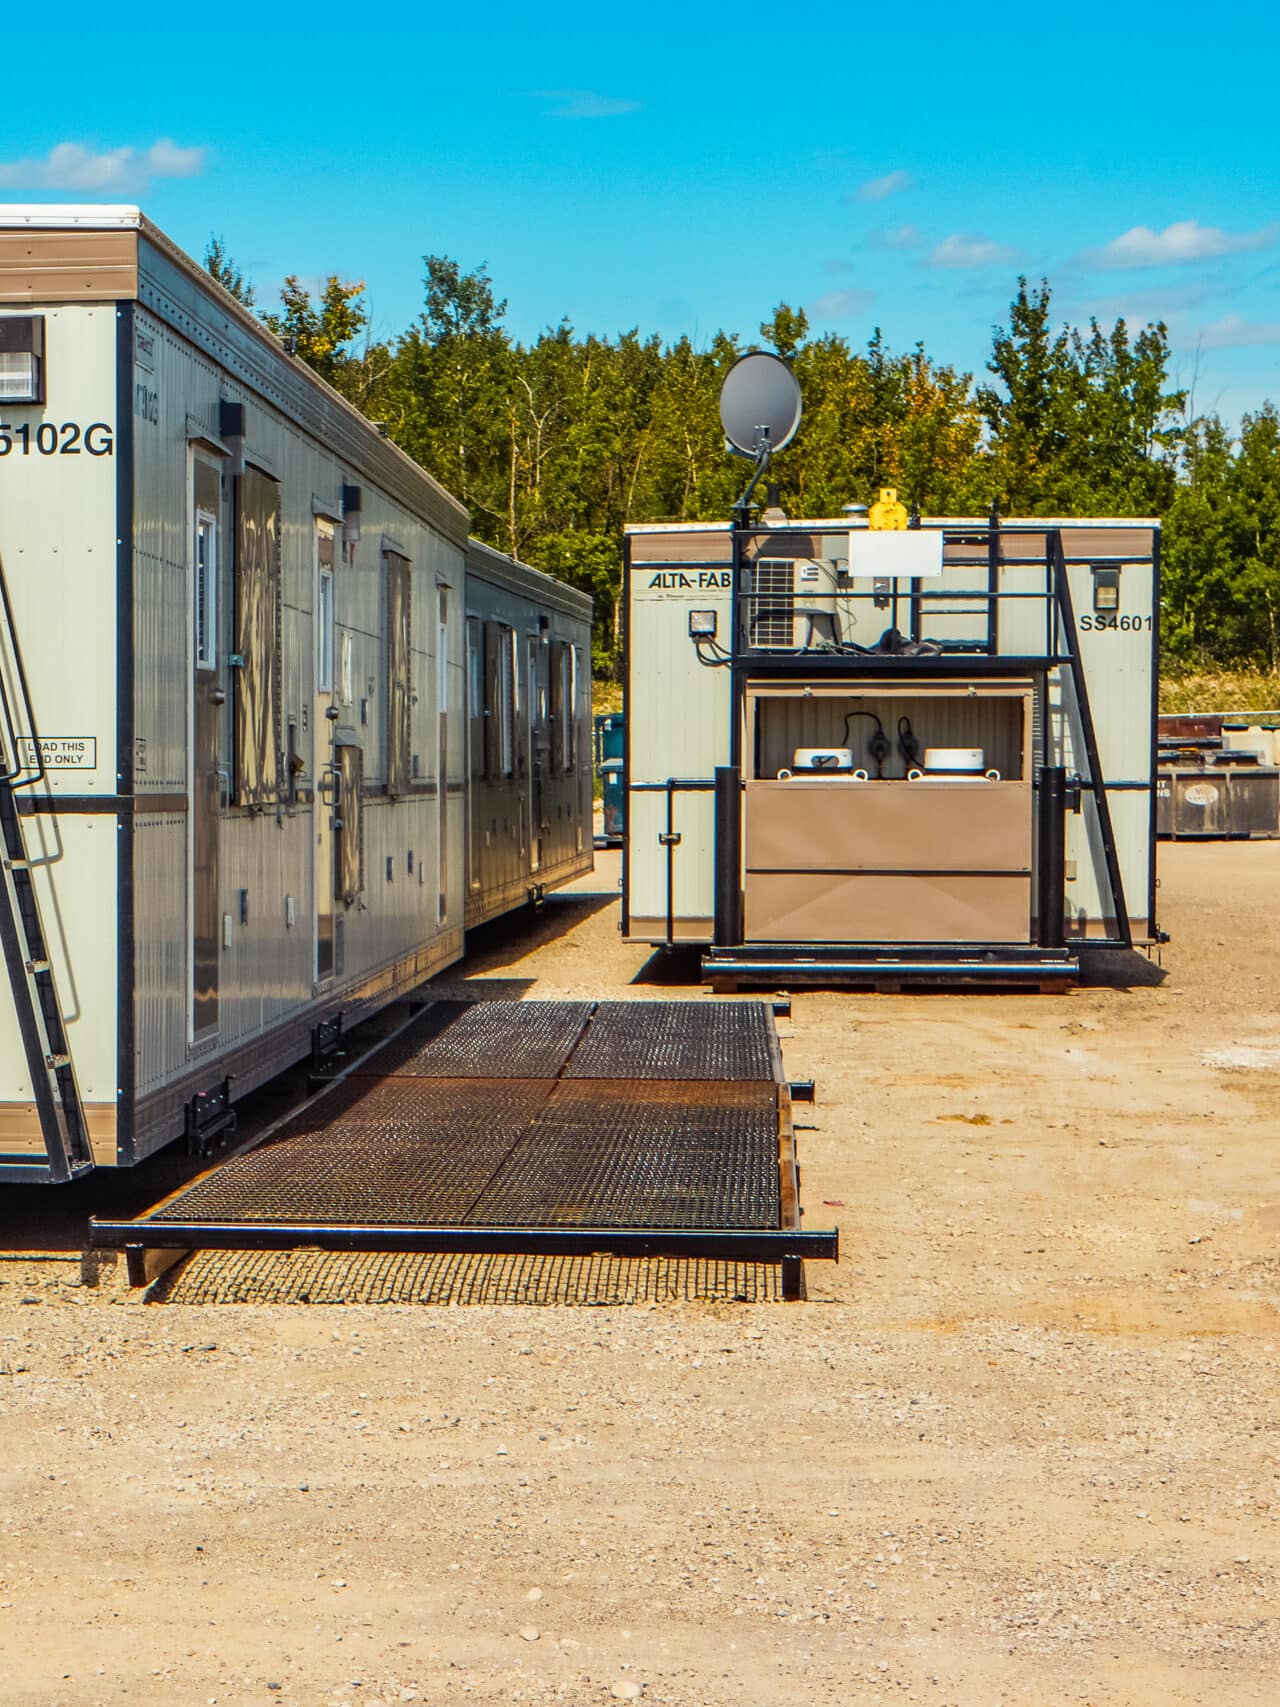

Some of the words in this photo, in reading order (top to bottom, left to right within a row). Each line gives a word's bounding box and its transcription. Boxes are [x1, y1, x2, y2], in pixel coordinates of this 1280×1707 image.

[648, 572, 731, 589] ALTA-FAB
[1080, 615, 1152, 631] SS4601
[61, 743, 85, 751] THIS
[30, 755, 51, 763] ED
[55, 755, 83, 763] ONLY
